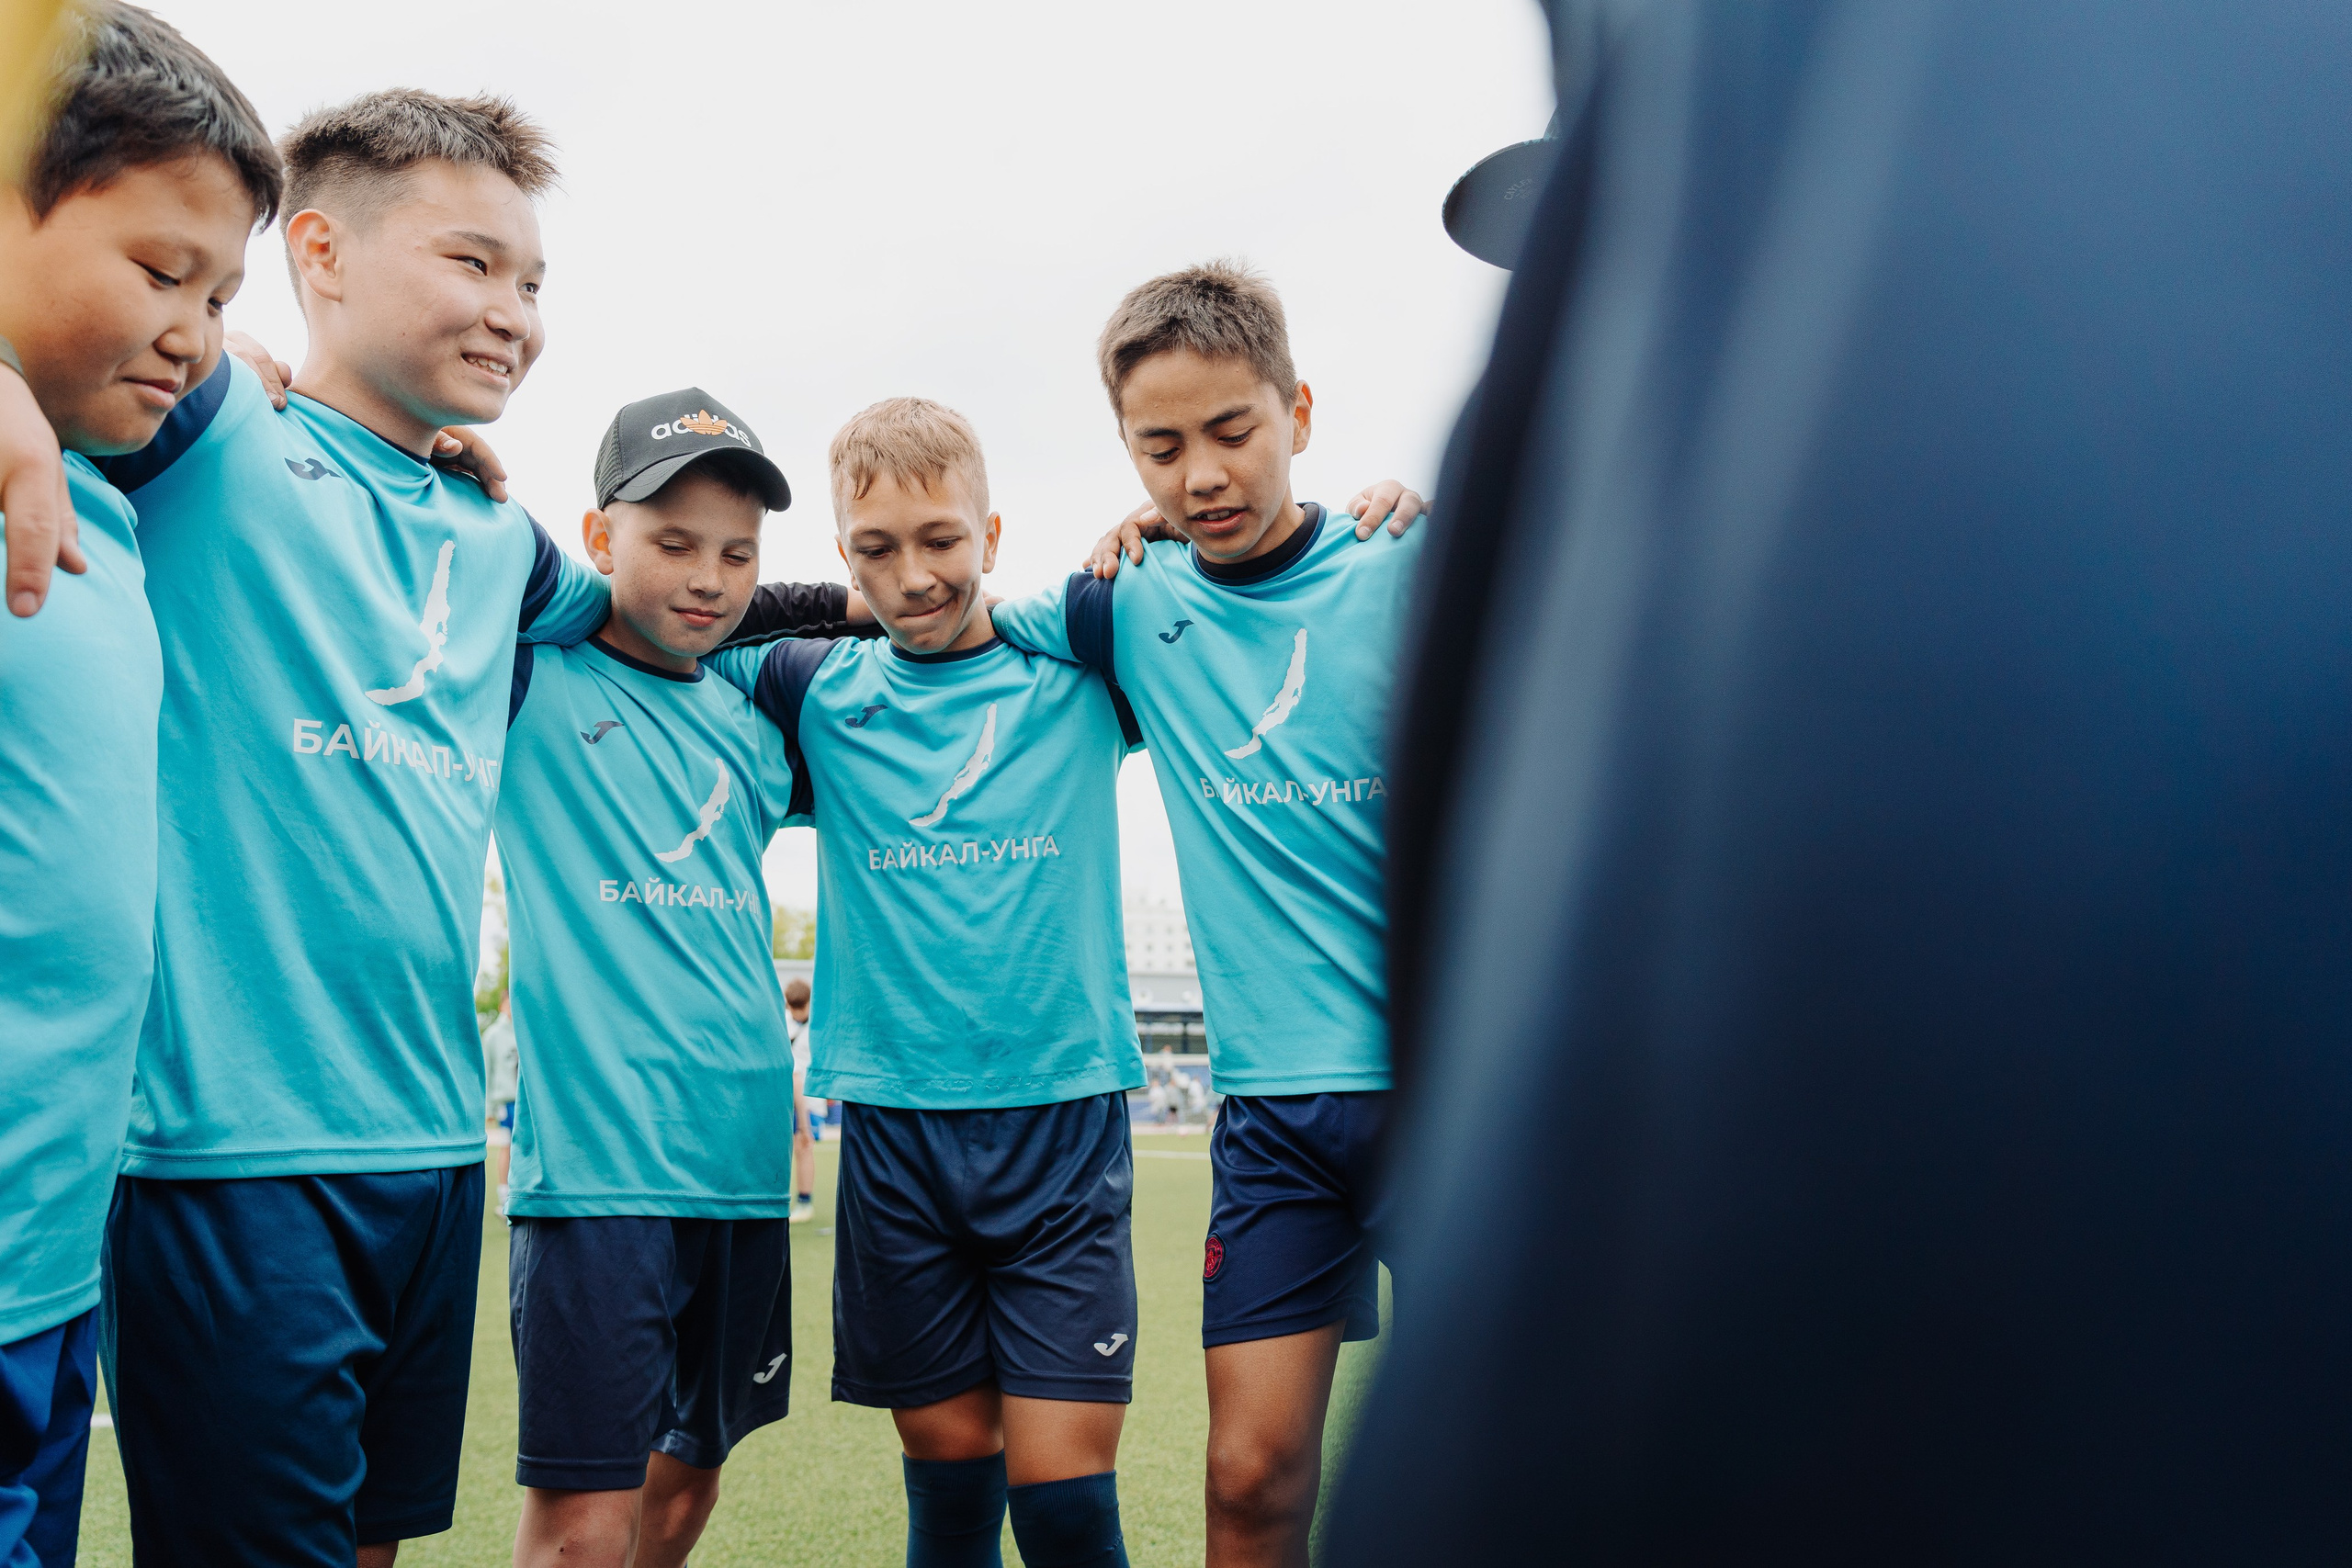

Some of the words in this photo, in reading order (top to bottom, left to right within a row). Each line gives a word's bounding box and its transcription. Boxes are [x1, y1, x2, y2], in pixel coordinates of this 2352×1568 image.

[650, 413, 752, 447] adas
[293, 718, 501, 793] БАЙКАЛ-УНГ
[868, 835, 1059, 870] БАЙКАЛ-УНГА
